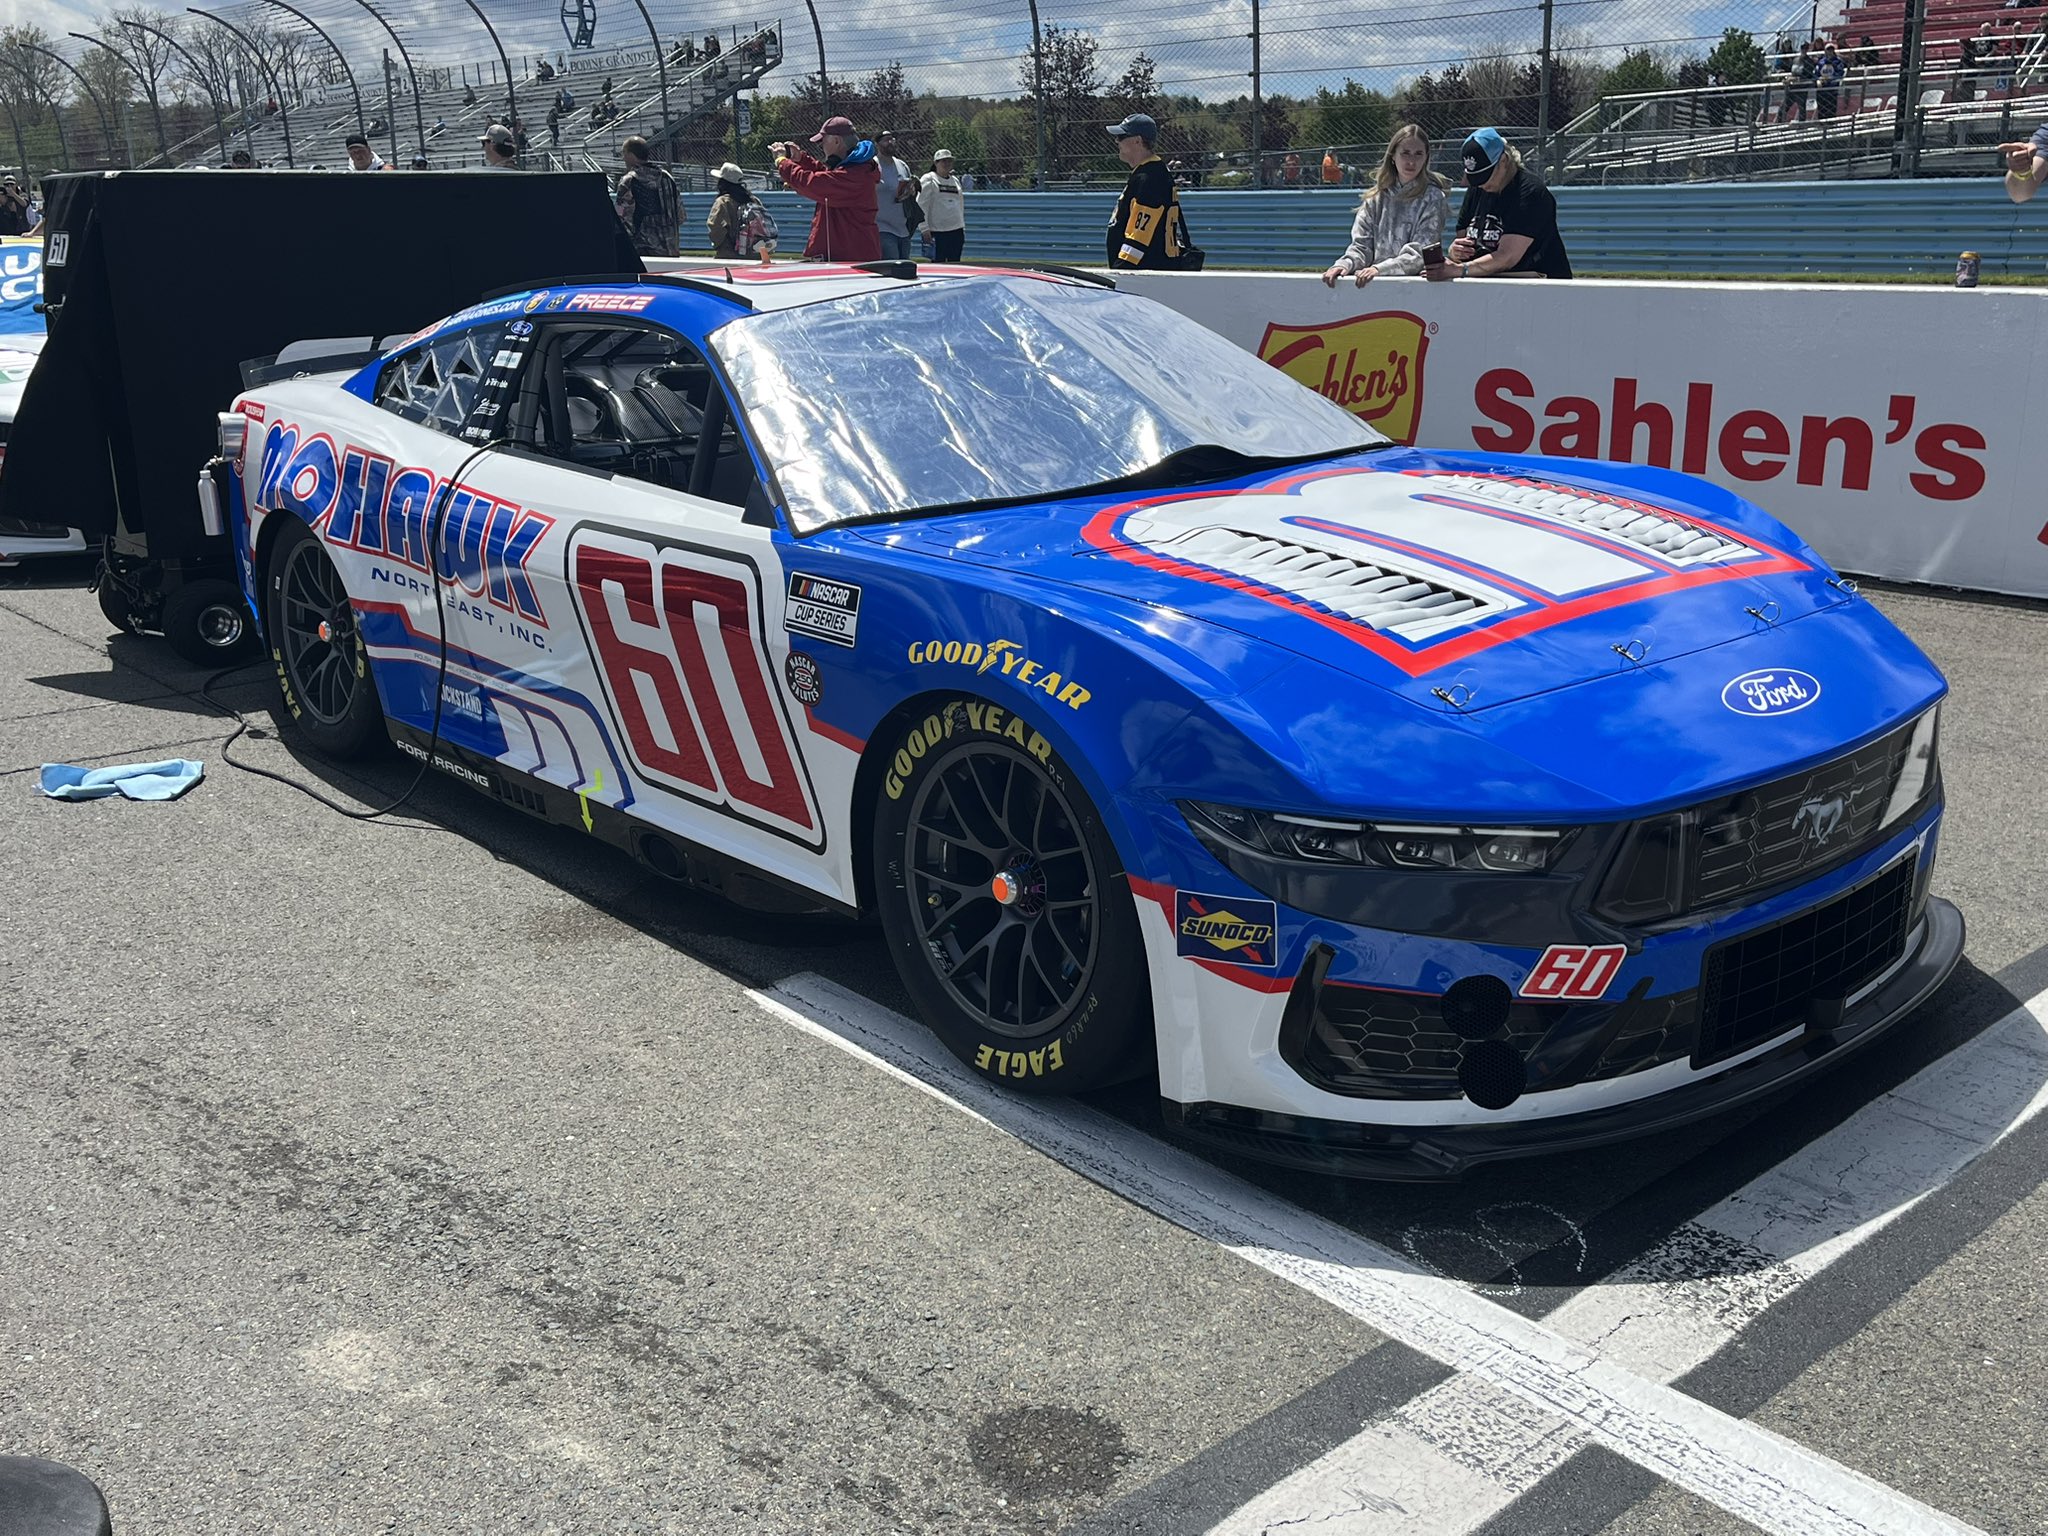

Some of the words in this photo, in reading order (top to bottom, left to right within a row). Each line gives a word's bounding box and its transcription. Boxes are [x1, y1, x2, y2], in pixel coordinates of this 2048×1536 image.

[570, 57, 603, 72] BODINE
[1134, 211, 1151, 231] 87
[47, 233, 69, 265] 60
[565, 293, 655, 312] PREECE
[1471, 368, 1987, 501] Sahlen's
[253, 418, 556, 630] MOHAWK
[810, 582, 850, 607] NASCAR
[795, 605, 815, 622] CUP
[815, 607, 847, 631] SERIES
[510, 622, 553, 653] INC.
[789, 656, 816, 675] NASCAR
[272, 647, 302, 720] EAGLE
[575, 543, 814, 832] 60
[791, 681, 820, 702] SALUTES
[1739, 674, 1808, 712] Ford
[434, 756, 489, 788] RACING
[1186, 918, 1270, 942] SUNOCO
[1519, 945, 1626, 999] 60
[974, 1037, 1065, 1078] EAGLE
